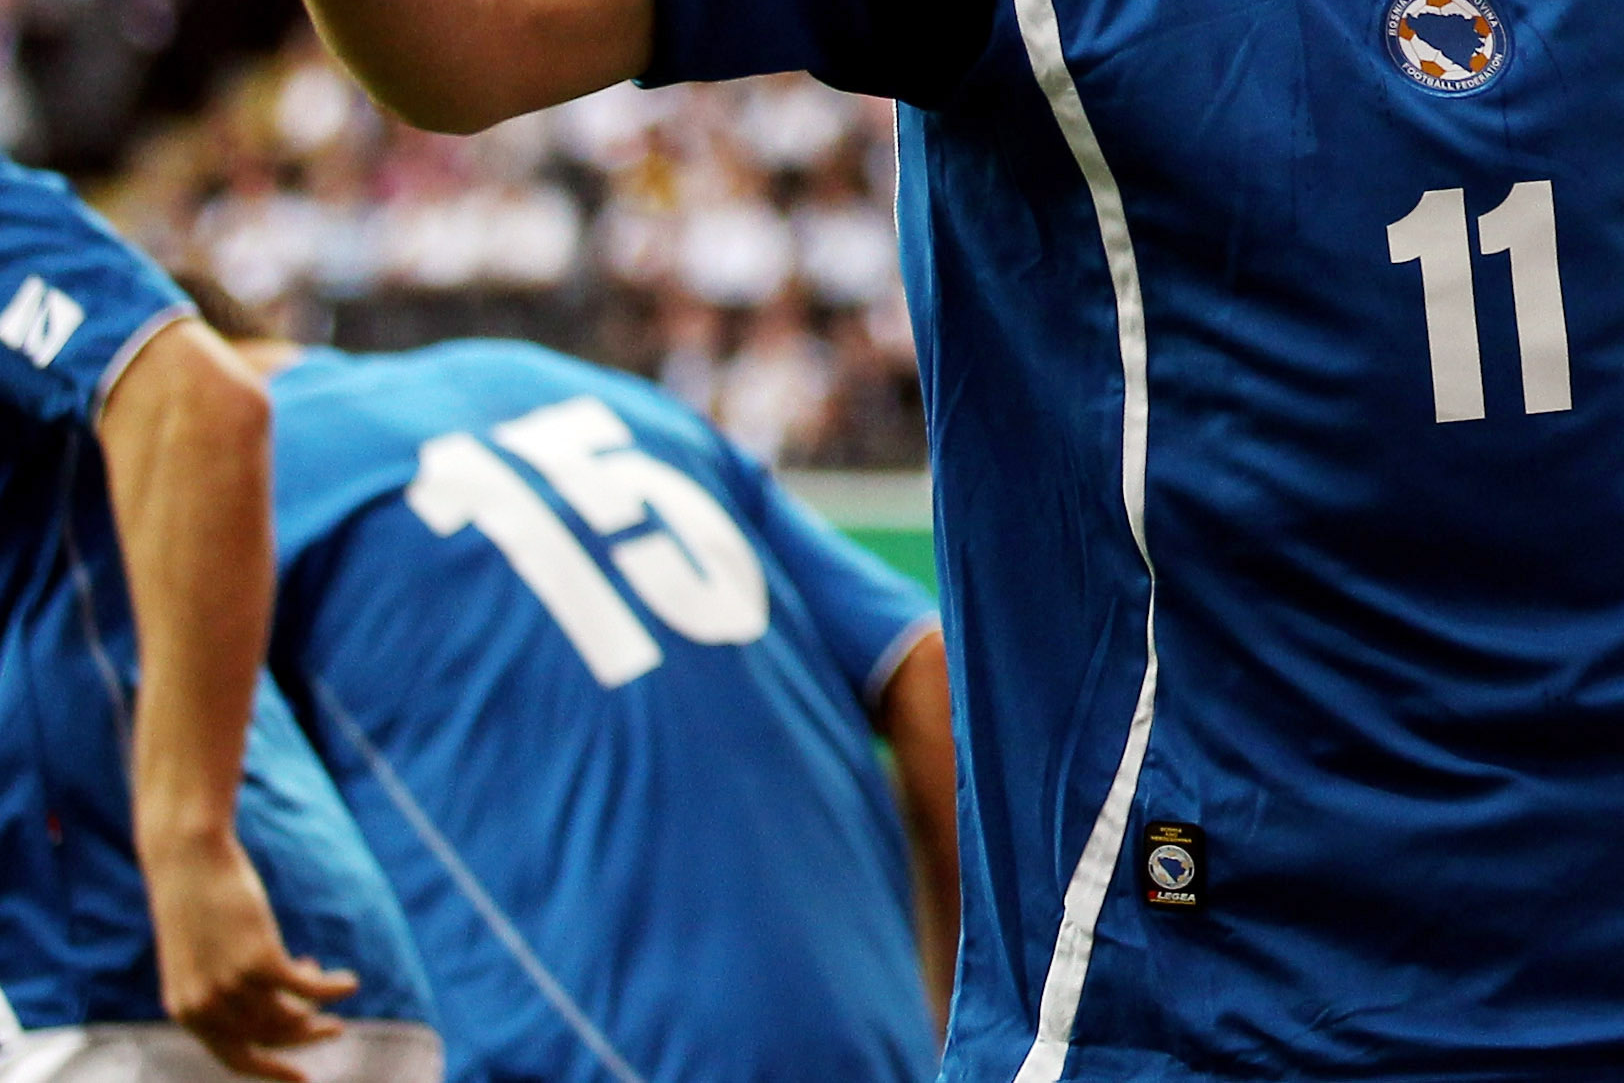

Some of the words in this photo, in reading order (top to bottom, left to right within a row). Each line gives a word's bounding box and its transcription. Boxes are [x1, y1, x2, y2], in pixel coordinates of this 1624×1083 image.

[1401, 62, 1456, 91] FOOTBALL
[1456, 53, 1503, 91] FEDERATION
[1386, 179, 1573, 424] 11
[404, 395, 769, 690] 15
[1156, 891, 1195, 902] LEGEA
